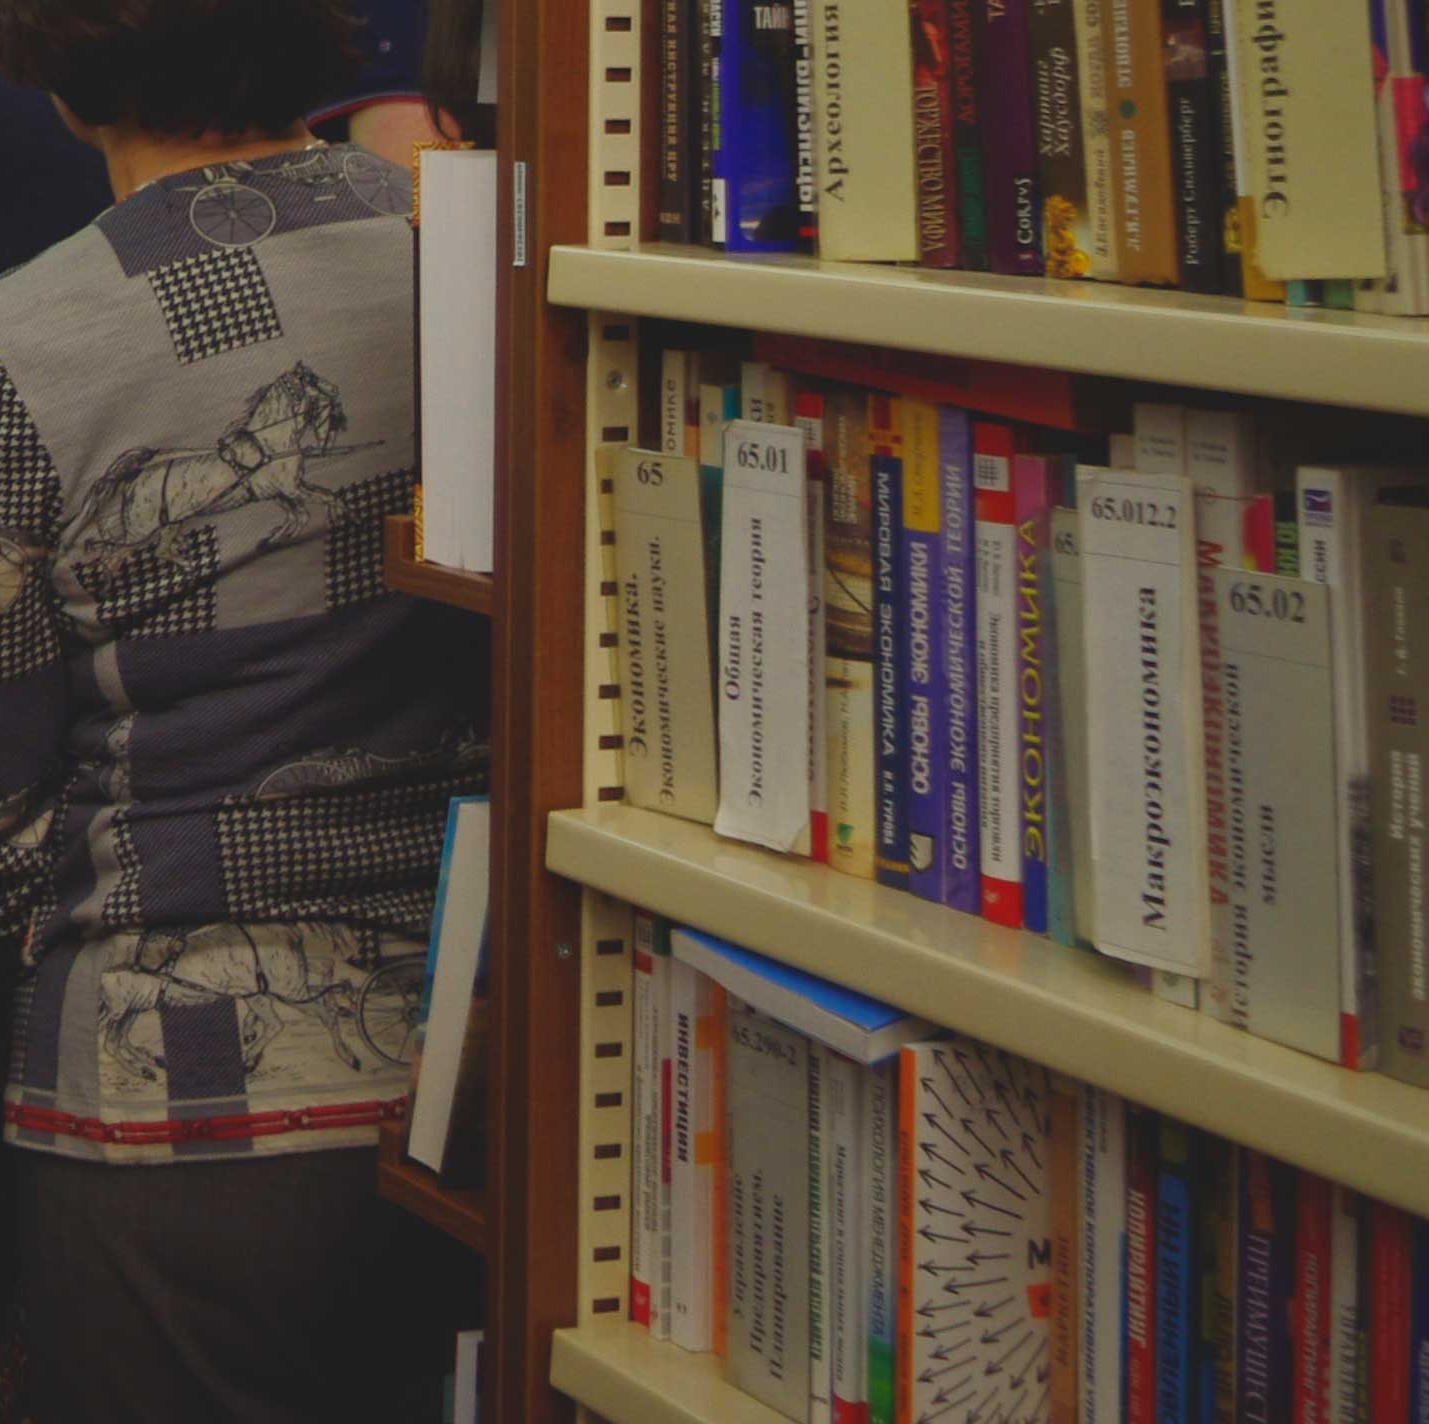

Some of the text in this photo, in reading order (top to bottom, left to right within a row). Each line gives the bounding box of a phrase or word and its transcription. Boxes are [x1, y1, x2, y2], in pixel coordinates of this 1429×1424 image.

[823, 3, 850, 202] Археология
[915, 84, 944, 253] ТОРЖЕСТВО МИФА
[1048, 47, 1072, 156] Хаусдорф
[637, 461, 664, 487] 65
[737, 441, 790, 475] 65.01
[876, 472, 892, 592] МИРОВАЯ
[1092, 496, 1177, 529] 65.012.2
[625, 573, 647, 757] Экономика.
[647, 535, 675, 803] Экономические науки.
[746, 517, 765, 806] Экономическая теория
[879, 603, 896, 756] ЭКОНОМИКА
[909, 541, 930, 685] ЭКОНОМИКИ
[943, 463, 968, 869] ОСНОВЫ ЭКОНОМИЧЕСКОЙ ТЕОРИИ
[1228, 581, 1306, 623] 65.02
[910, 695, 931, 795] ОСНОВЫ
[1020, 518, 1046, 864] ЭКОНОМИКА
[1138, 587, 1171, 932] Макроэкономика
[1224, 663, 1248, 889] экономической
[1259, 804, 1275, 906] мысли
[677, 1013, 690, 1163] ИНВЕСТИЦИИ
[769, 1194, 787, 1380] Планирование
[870, 1081, 885, 1336] ПСИХОЛОГИЯ МЕНЕДЖМЕНТА
